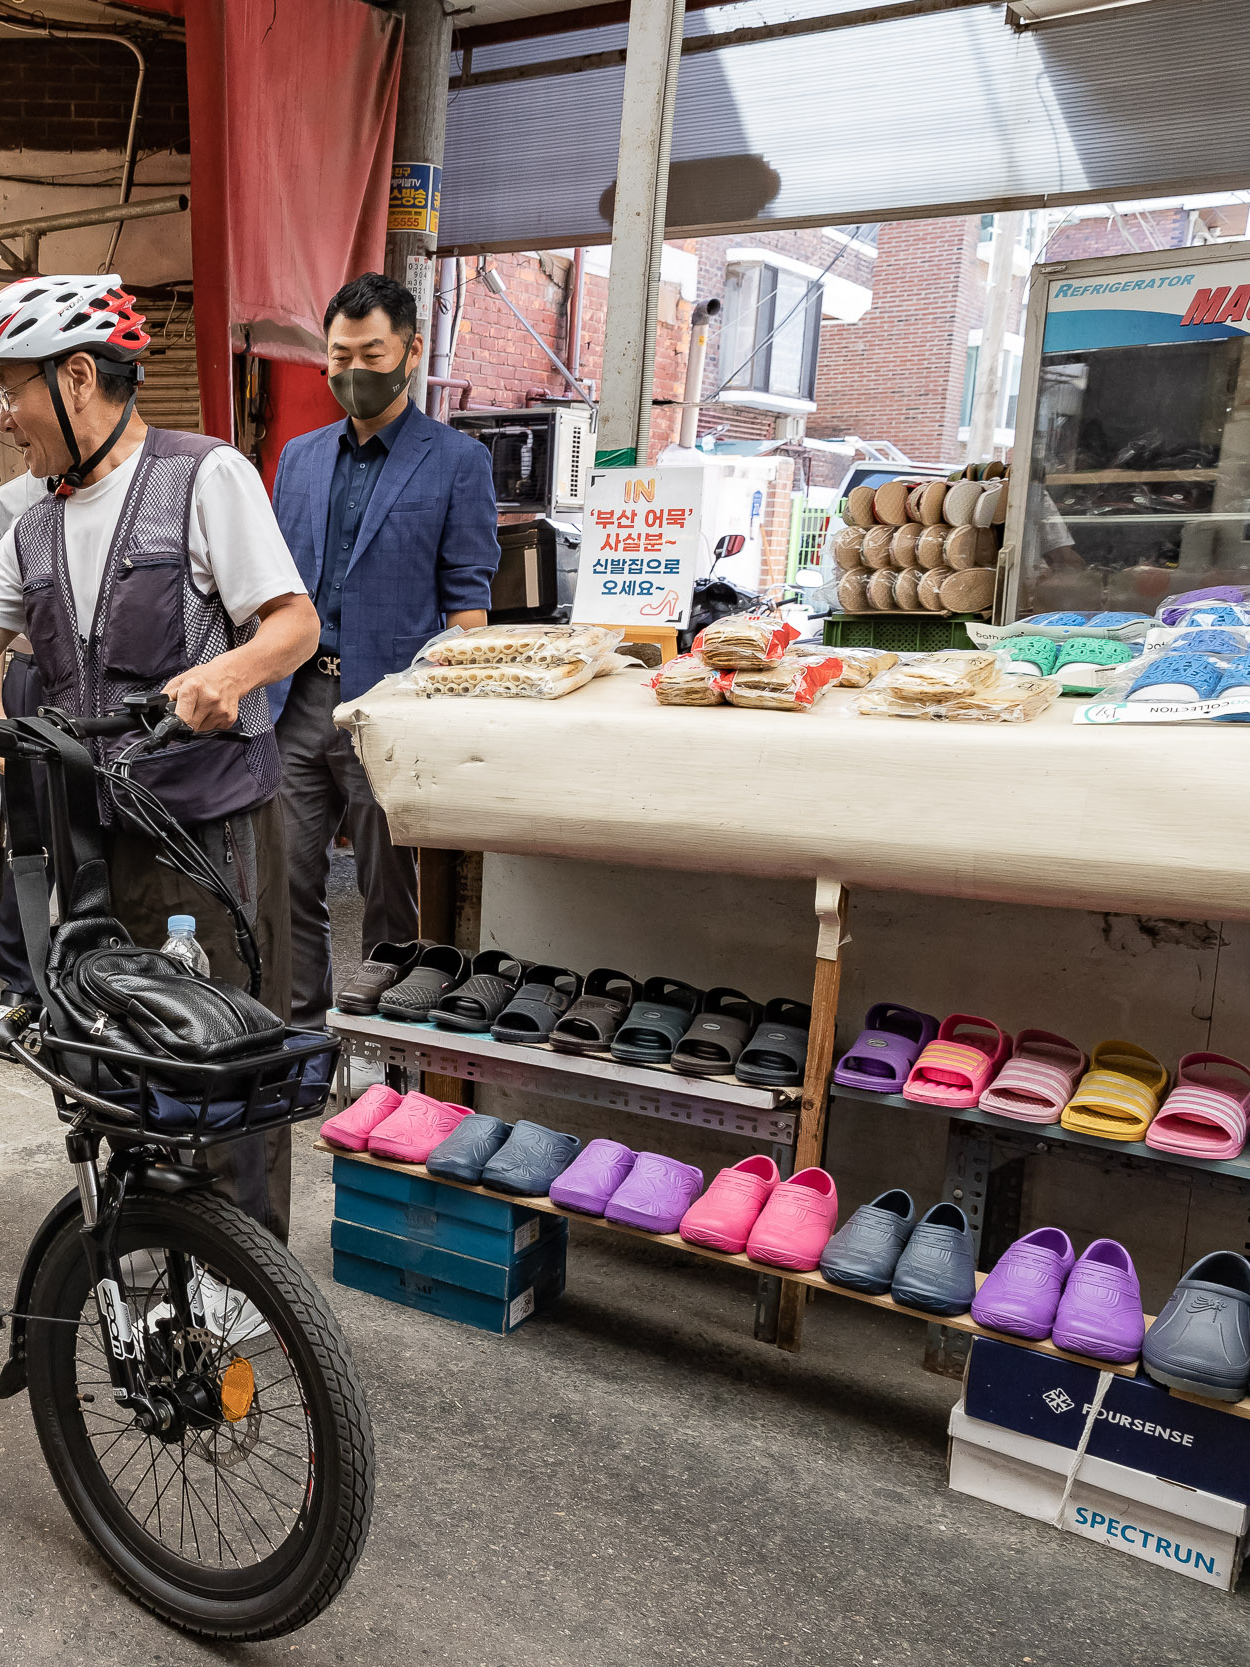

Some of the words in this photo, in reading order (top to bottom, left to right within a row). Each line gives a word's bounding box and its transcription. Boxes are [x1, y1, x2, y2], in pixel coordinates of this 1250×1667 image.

[1053, 273, 1196, 299] REFRIGERATOR
[1180, 283, 1250, 327] MA
[623, 478, 656, 503] IN
[600, 532, 677, 553] 사실분~
[592, 558, 681, 576] 신발집으로
[600, 580, 665, 597] 오세요~
[1082, 1402, 1195, 1448] FOURSENSE
[1075, 1505, 1216, 1575] SPECTRUN
